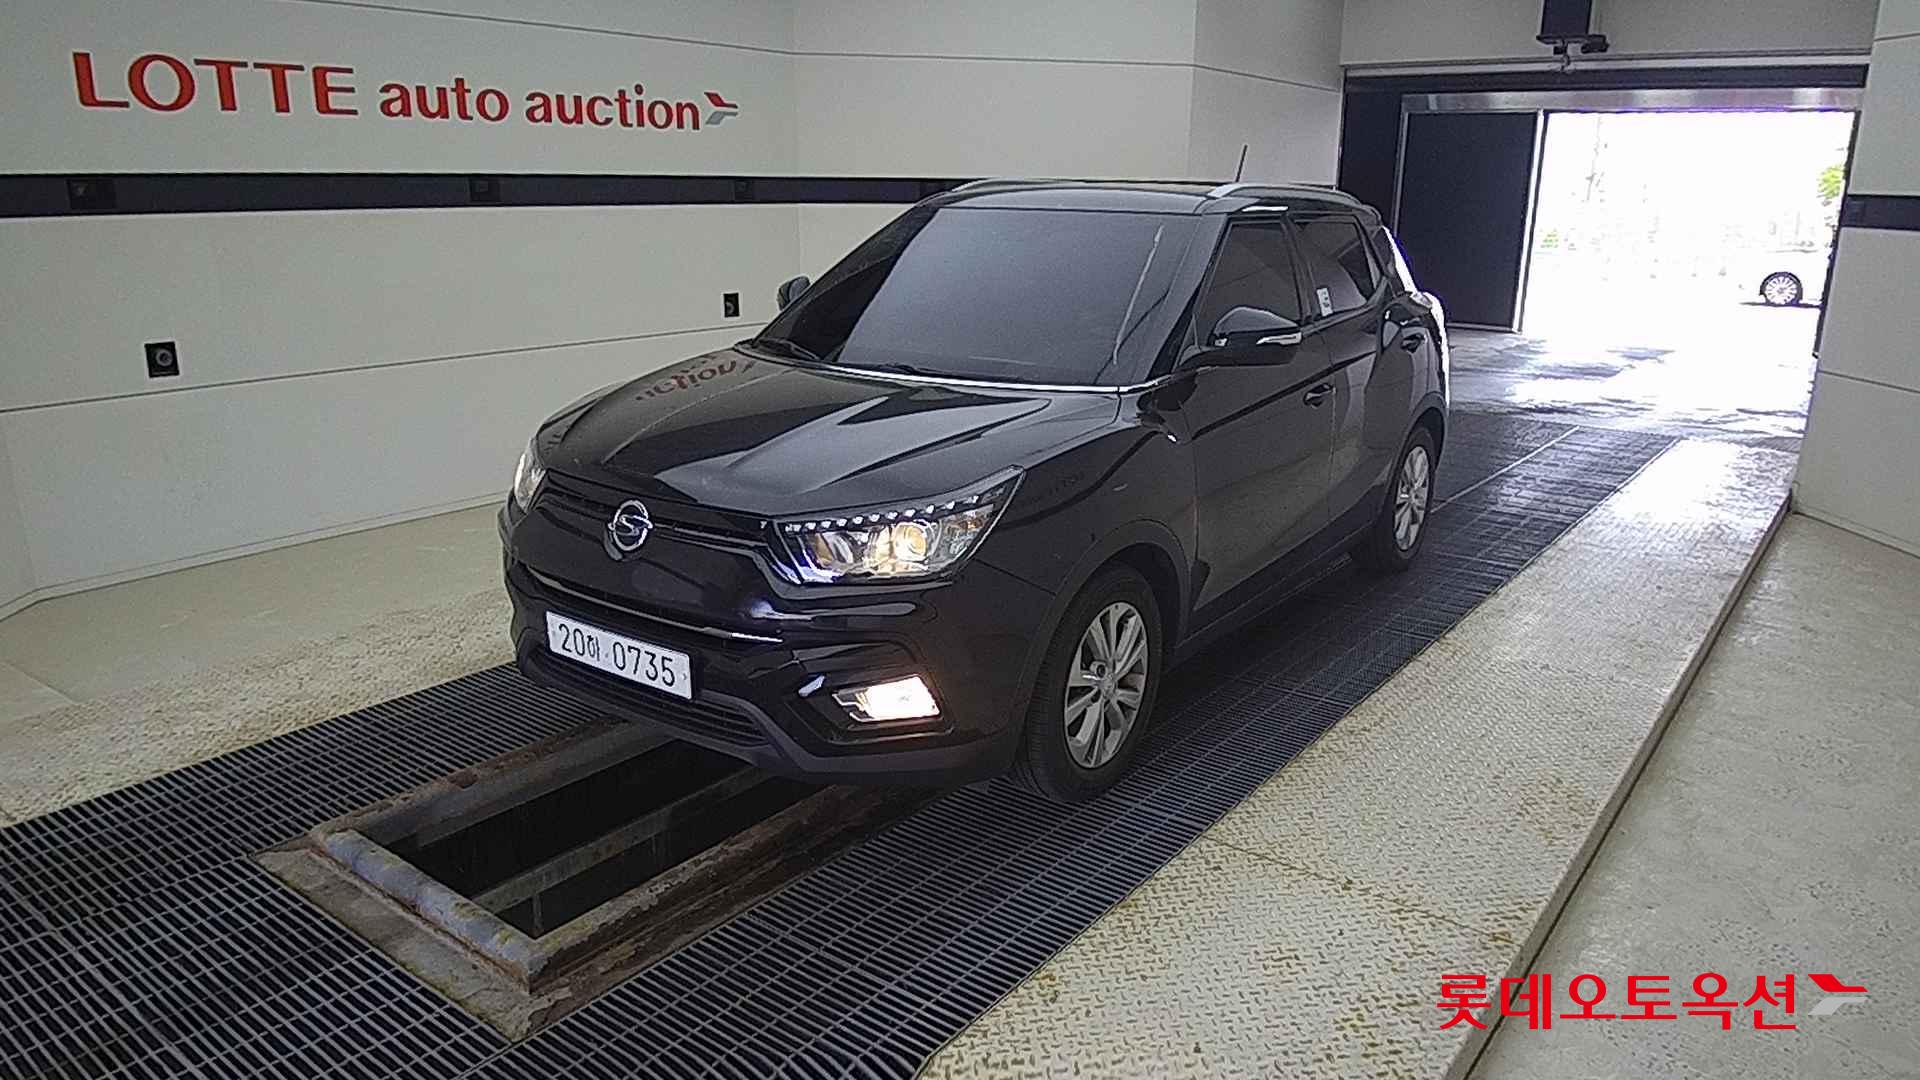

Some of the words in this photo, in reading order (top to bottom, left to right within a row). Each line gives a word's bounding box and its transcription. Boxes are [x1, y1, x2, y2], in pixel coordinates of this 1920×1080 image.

[73, 52, 358, 115] LOTTE
[380, 78, 509, 122] auto
[526, 85, 700, 131] auction
[558, 623, 601, 662] 20하
[612, 641, 676, 687] 0735
